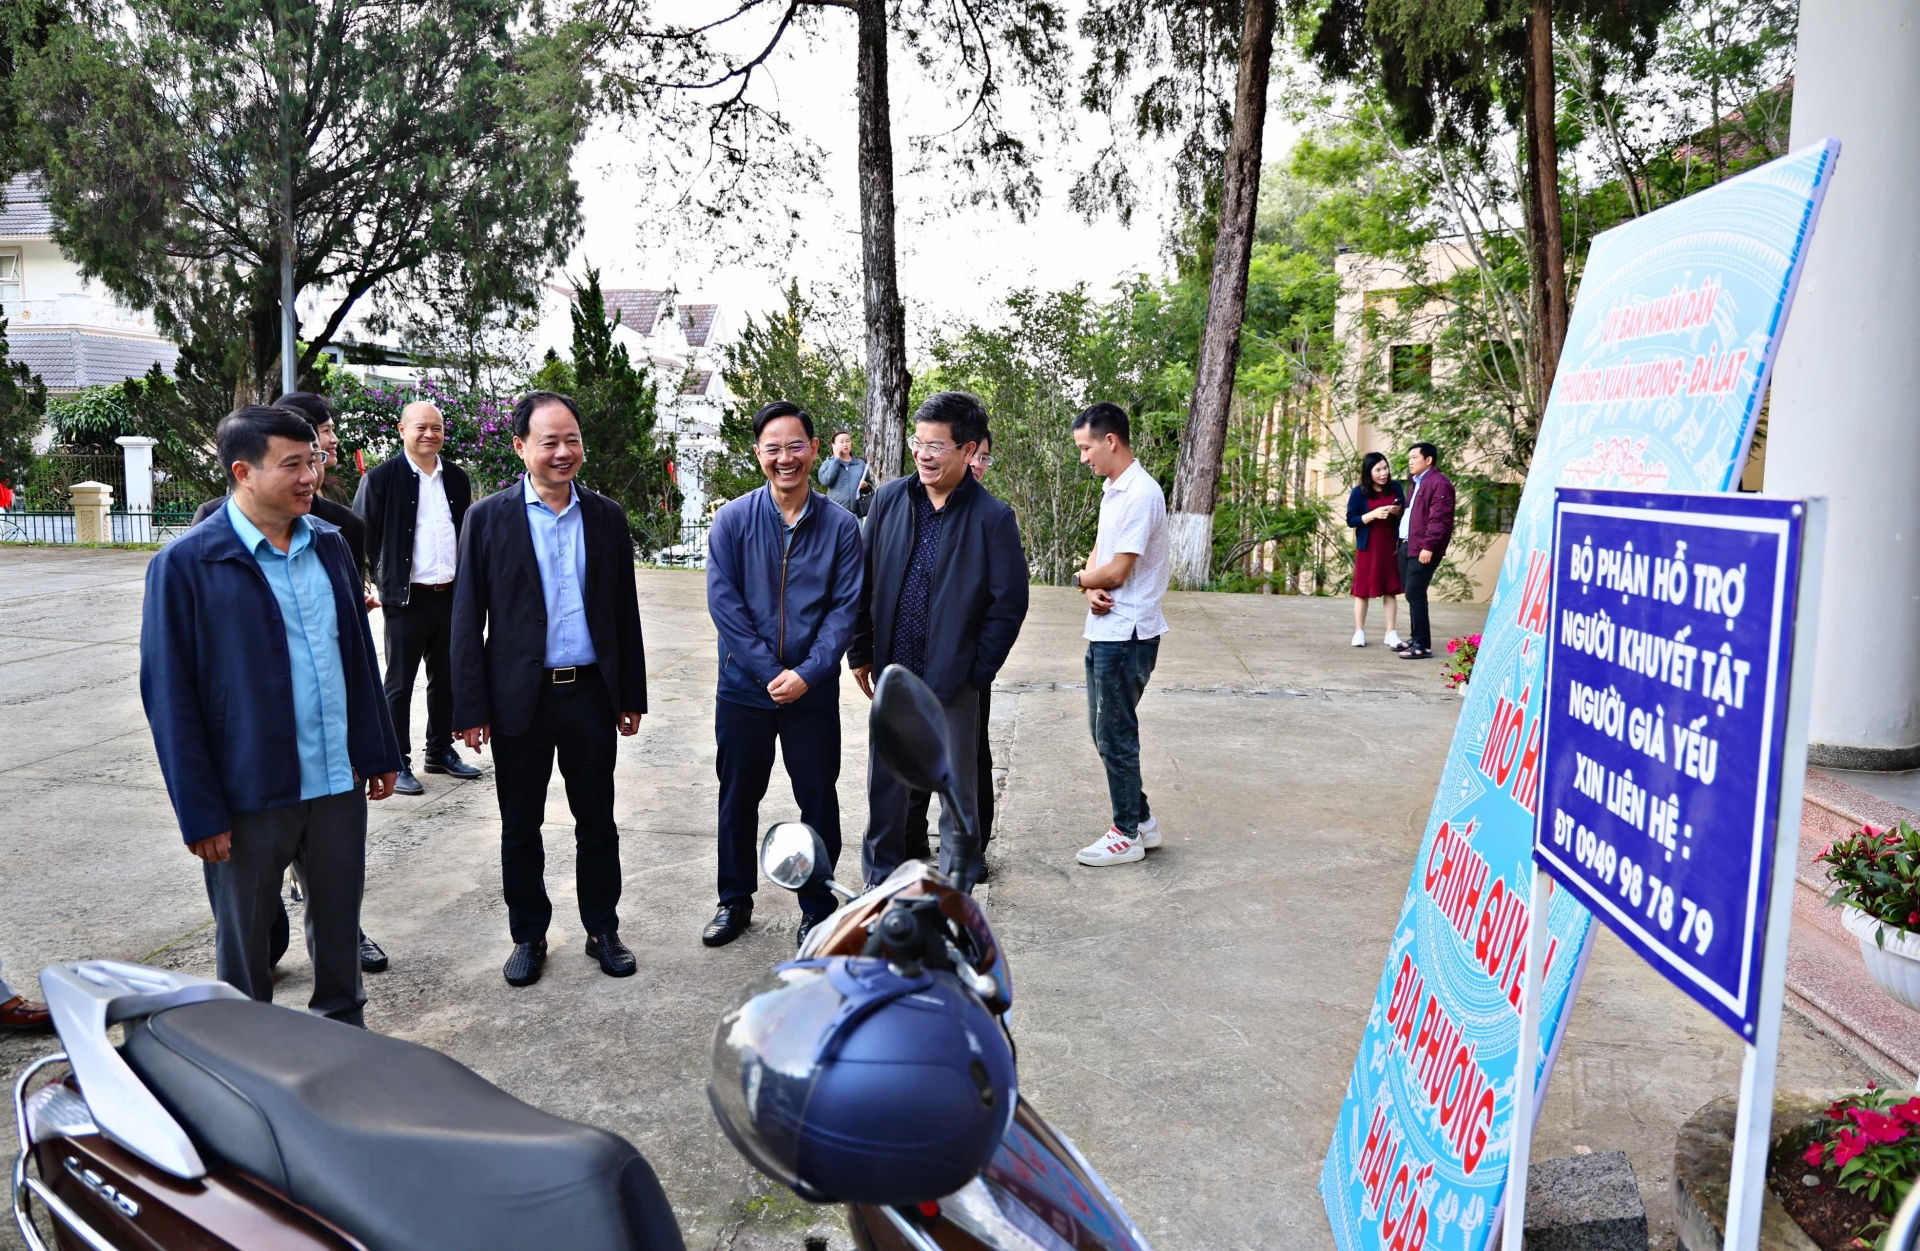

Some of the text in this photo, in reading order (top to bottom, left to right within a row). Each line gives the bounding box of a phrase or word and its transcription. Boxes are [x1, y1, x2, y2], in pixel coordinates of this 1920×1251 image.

[1617, 303, 1647, 340] BAN
[1643, 286, 1686, 335] NHÂN
[1681, 279, 1719, 329] DÂN
[1599, 358, 1635, 400] XUÂN
[1632, 355, 1683, 398] HƯƠNG
[1712, 350, 1748, 404] LẠT
[1570, 535, 1747, 631] BỘ PHẬN HỖ TRỢ
[1561, 608, 1751, 717] NGƯỜI KHUYẾT TẬT
[1480, 686, 1530, 787] MÔ
[1569, 684, 1719, 785] NGƯỜI GIÀ YẾU
[1573, 752, 1604, 804] XIN
[1606, 768, 1646, 831] LIÊN
[1425, 819, 1489, 941] CHÍNH
[1476, 877, 1557, 1016] QUY
[1554, 808, 1714, 956] ĐT 0949 98 78 79
[1387, 953, 1495, 1175] ĐỊA PHƯƠNG
[1359, 1105, 1397, 1213] HAI
